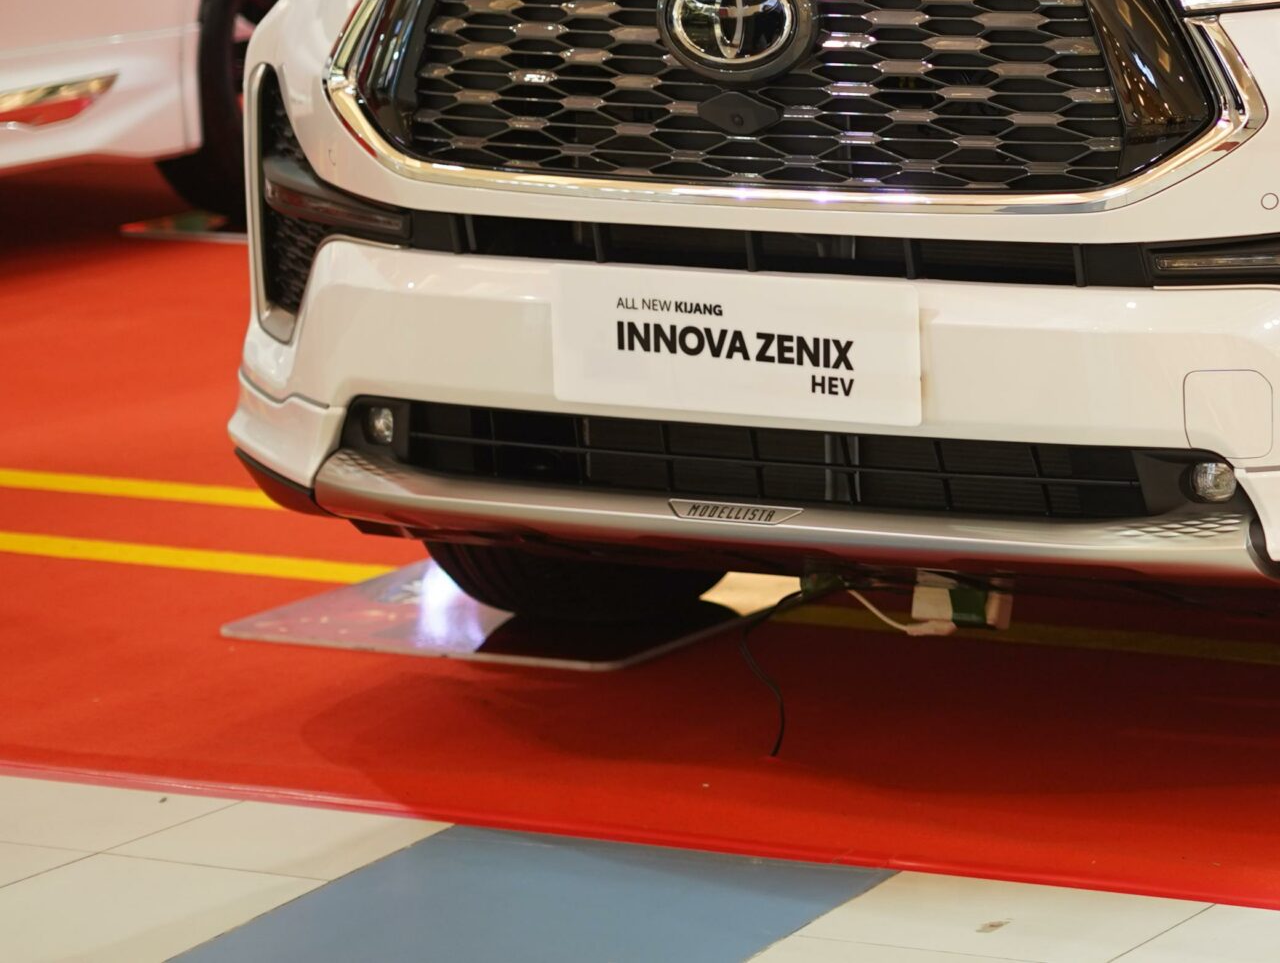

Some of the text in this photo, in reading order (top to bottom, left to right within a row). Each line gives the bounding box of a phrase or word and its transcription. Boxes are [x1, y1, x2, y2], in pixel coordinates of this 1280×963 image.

[616, 297, 723, 317] ALL NEW KIJANG
[616, 320, 854, 371] INNOVA ZENIX
[811, 374, 855, 397] HEV
[687, 504, 776, 522] MODELLISTA
